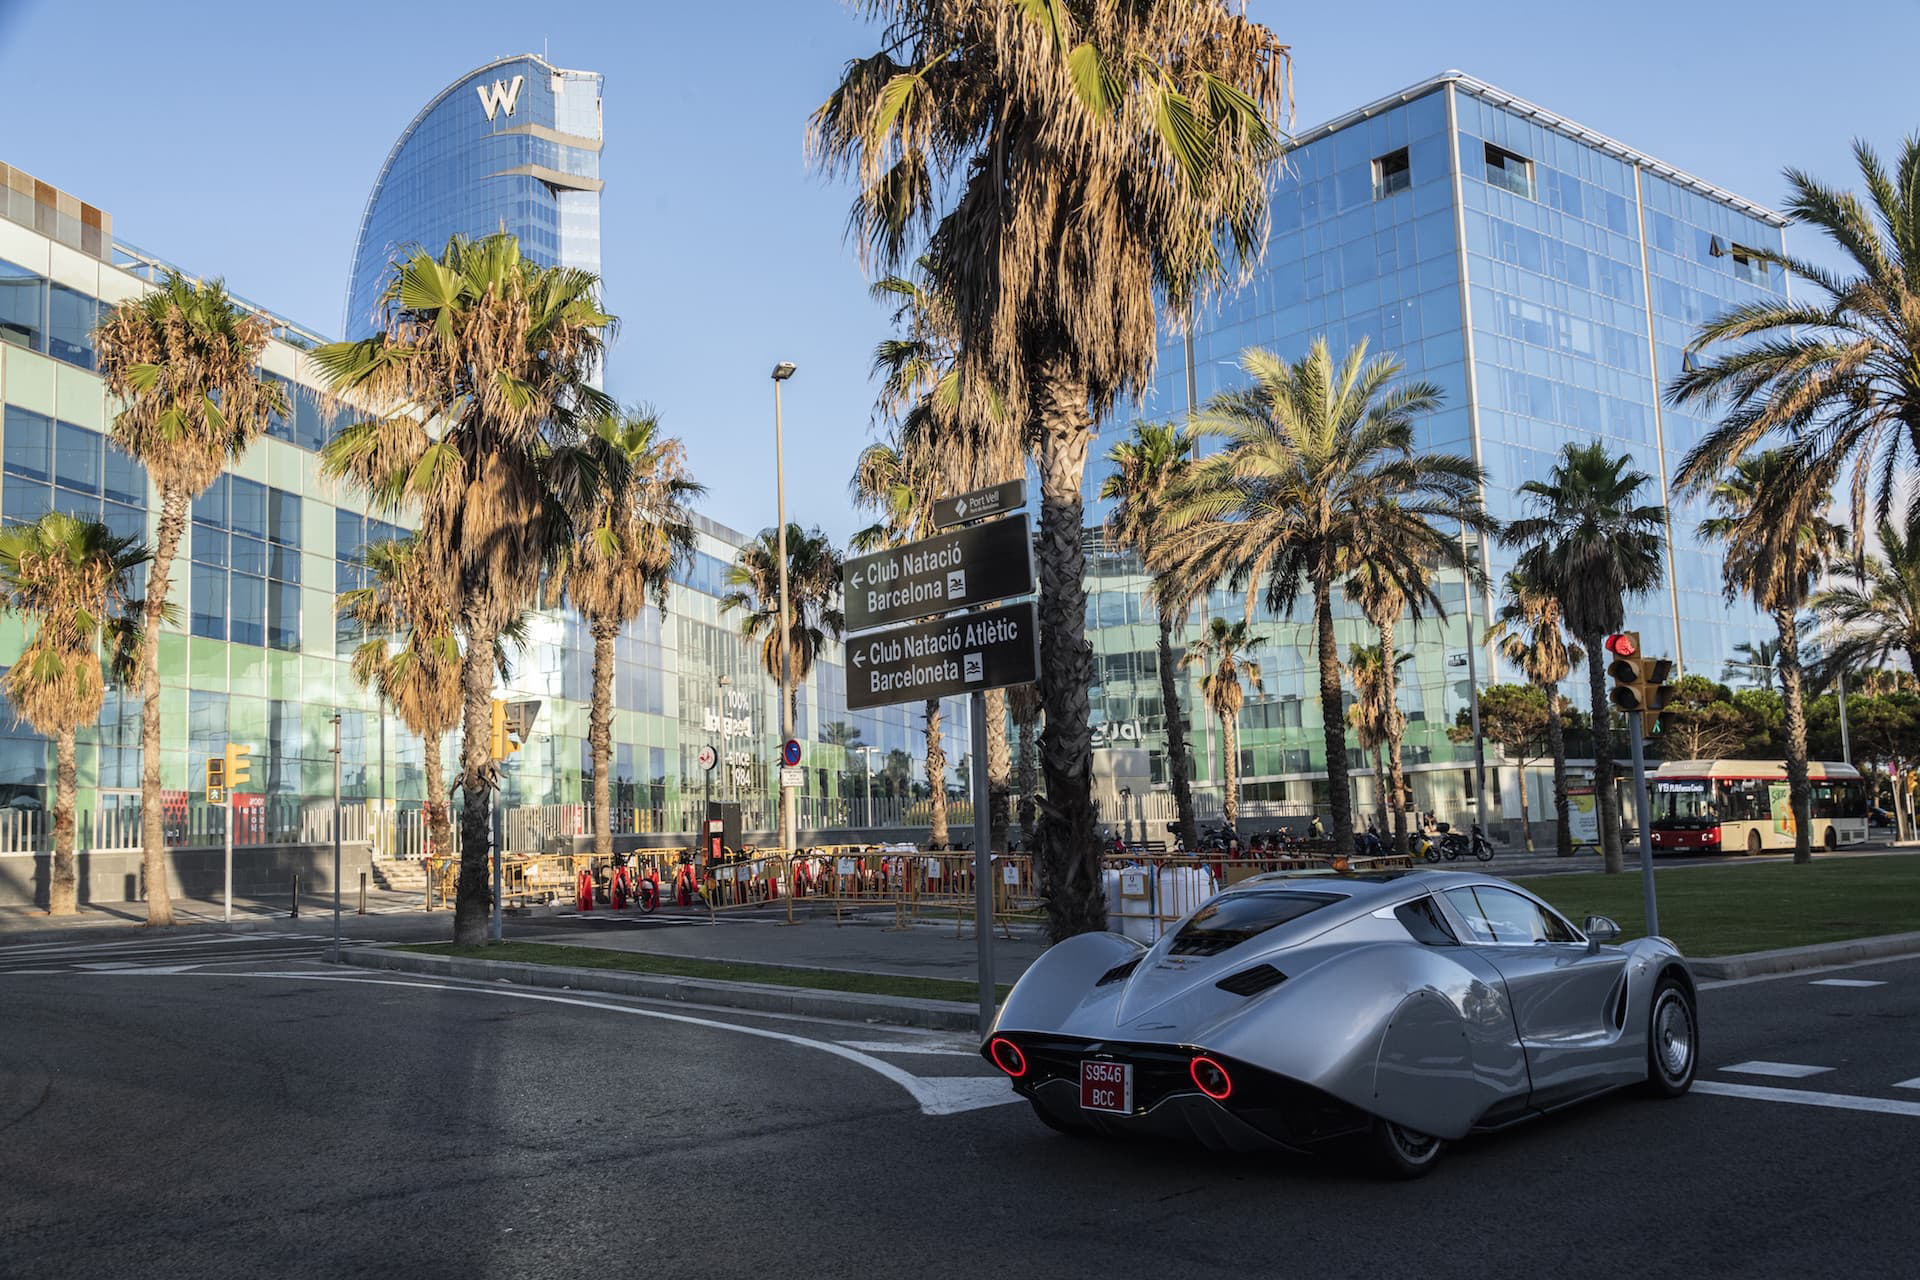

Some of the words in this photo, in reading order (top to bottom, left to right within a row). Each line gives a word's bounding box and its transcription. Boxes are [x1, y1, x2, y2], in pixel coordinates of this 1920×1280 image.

[476, 75, 525, 121] W
[867, 560, 899, 586] Club
[903, 541, 962, 576] Natació
[867, 580, 943, 613] Barcelona
[869, 640, 902, 665] Club
[904, 626, 962, 659] Natació
[965, 618, 1018, 648] Atlètic
[870, 661, 960, 693] Barceloneta
[1086, 1064, 1122, 1083] S9546
[1093, 1088, 1115, 1107] BCC
